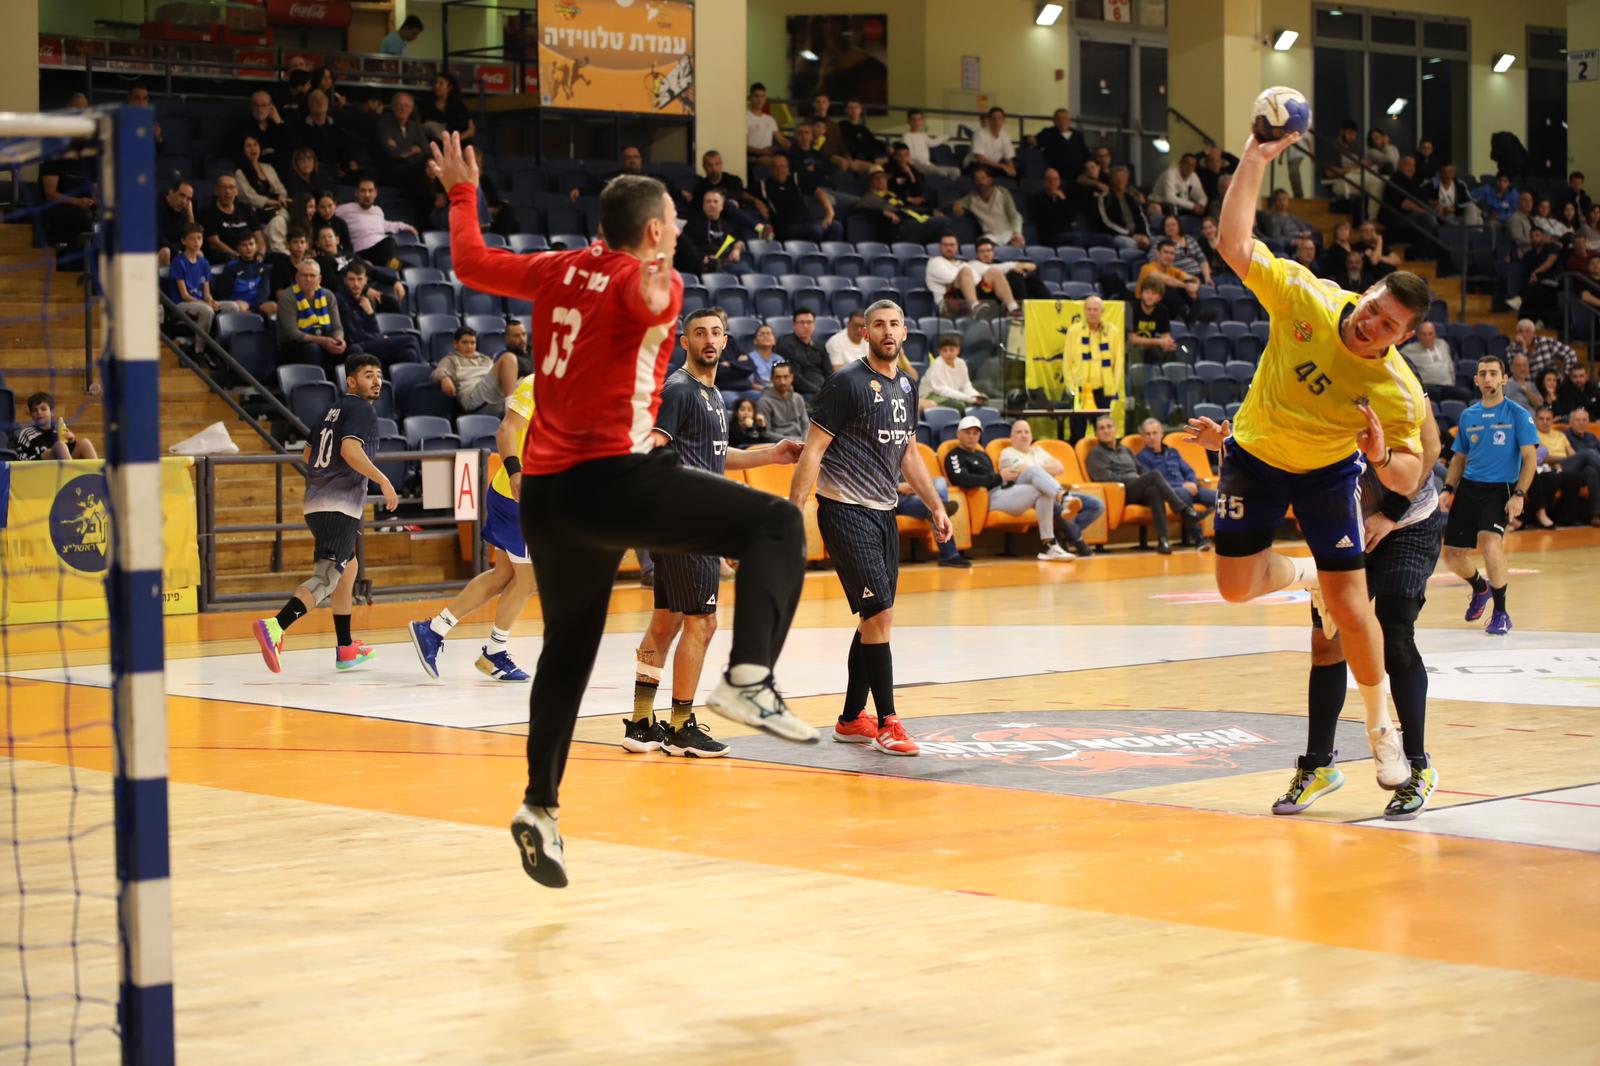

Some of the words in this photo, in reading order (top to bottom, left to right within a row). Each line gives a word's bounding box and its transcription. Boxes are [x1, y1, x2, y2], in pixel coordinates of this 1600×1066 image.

[544, 25, 625, 50] טלוויזיה
[628, 33, 688, 55] עמדת
[1578, 61, 1588, 80] 2
[1294, 361, 1332, 396] 45
[891, 398, 907, 423] 25
[313, 427, 334, 468] 10
[457, 463, 475, 510] A
[1217, 494, 1245, 520] 45
[916, 740, 1076, 754] LEZIO
[1072, 727, 1265, 749] RISHON
